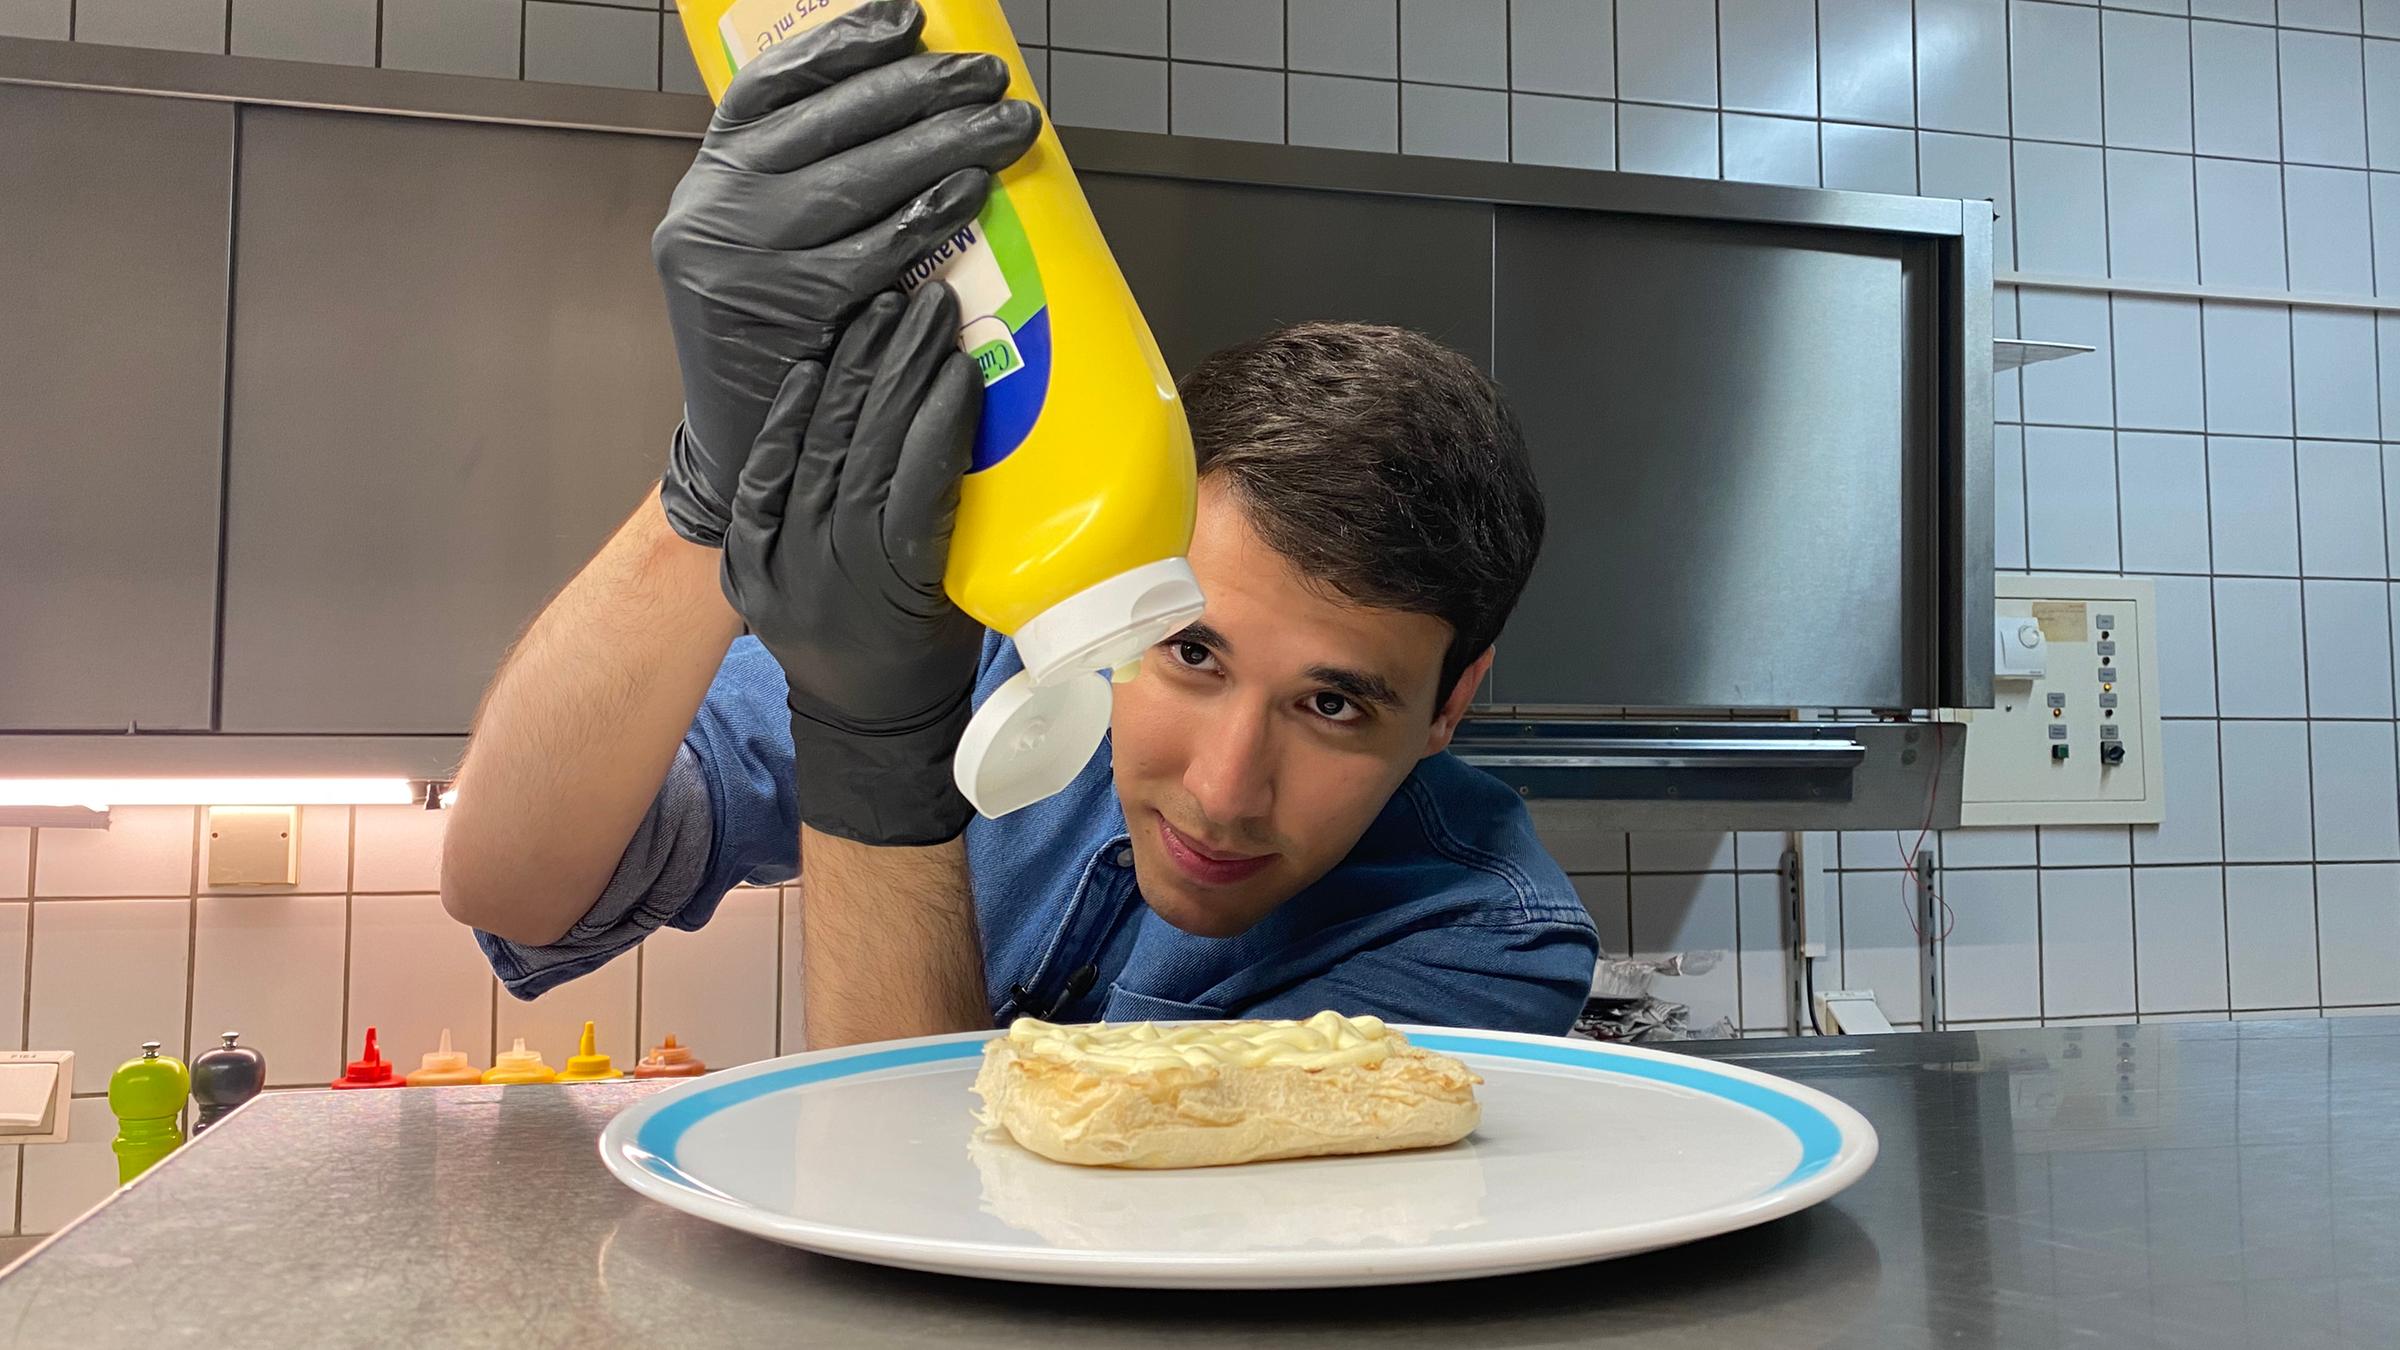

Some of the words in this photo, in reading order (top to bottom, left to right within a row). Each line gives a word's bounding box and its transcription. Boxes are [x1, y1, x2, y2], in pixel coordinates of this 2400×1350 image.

[773, 13, 795, 41] ml
[897, 225, 977, 291] Mayon
[976, 343, 1010, 379] Cui
